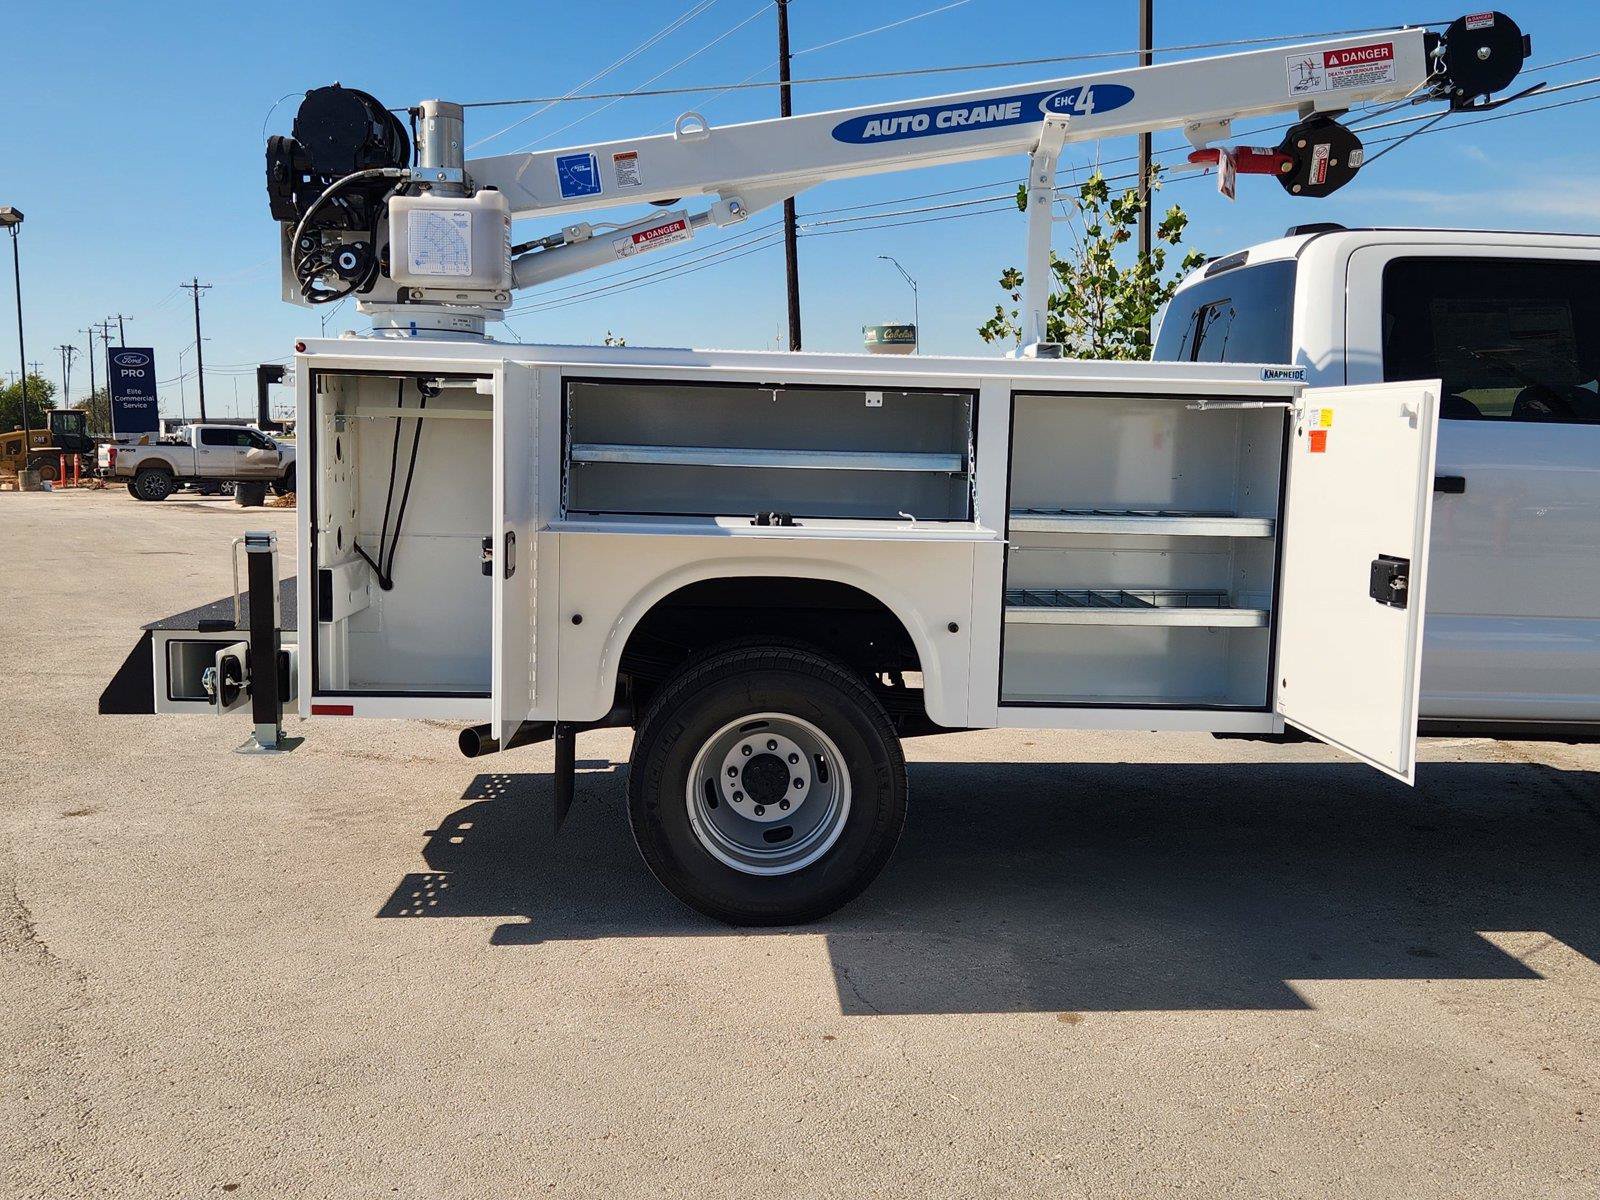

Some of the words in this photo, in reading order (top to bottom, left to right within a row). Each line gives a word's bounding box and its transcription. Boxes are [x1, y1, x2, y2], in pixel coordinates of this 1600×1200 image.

[1342, 47, 1389, 63] DANGER
[1054, 95, 1075, 107] EHC
[1074, 84, 1095, 117] 4
[862, 113, 930, 138] AUTO
[936, 102, 1022, 128] CRANE
[646, 223, 680, 239] DANGER
[121, 355, 142, 364] Ford
[120, 369, 145, 378] PRO
[1264, 368, 1304, 380] KNAPHEIDE
